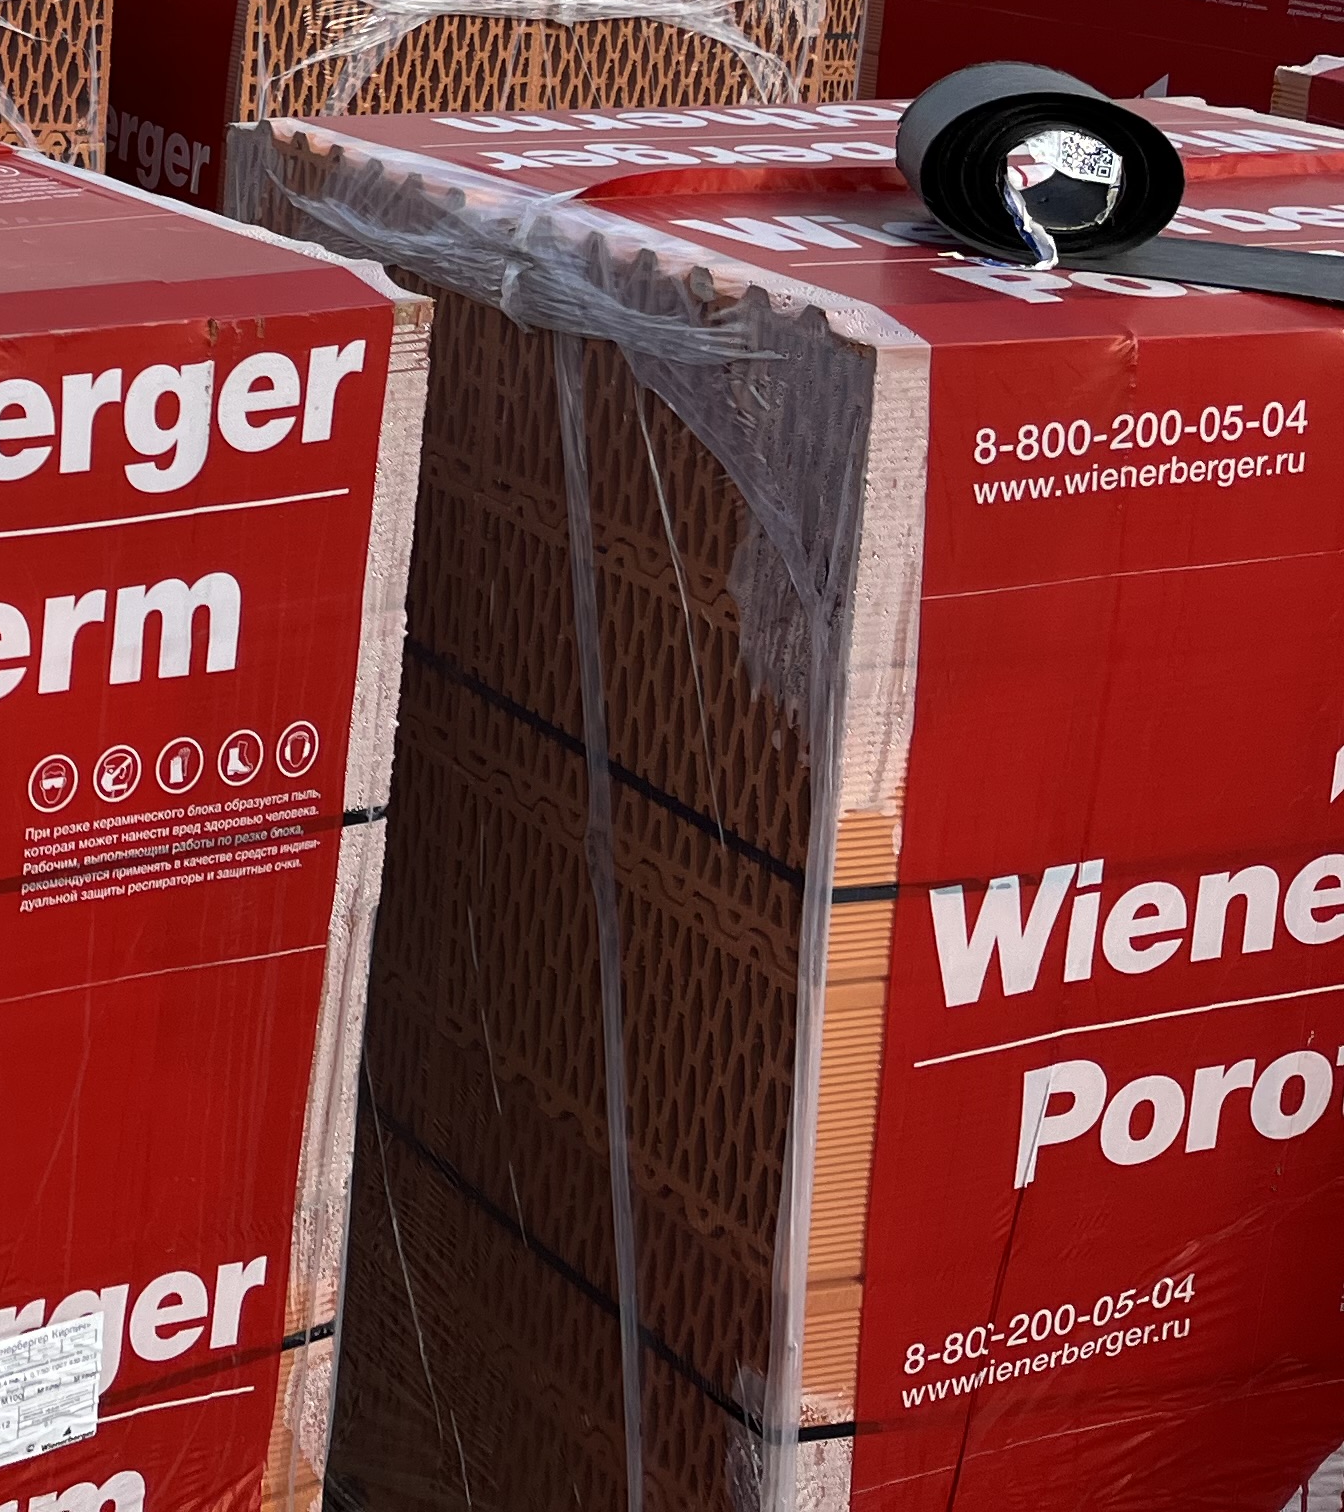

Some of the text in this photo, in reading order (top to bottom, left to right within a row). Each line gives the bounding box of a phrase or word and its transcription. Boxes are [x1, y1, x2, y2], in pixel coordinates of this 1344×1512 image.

[973, 399, 1309, 465] 8-800-200-05-04
[973, 451, 1306, 506] www.wienerberger.ru
[24, 805, 319, 859] которая может нанести вред здоровью человека.
[25, 789, 321, 842] При резке керамического блока образуется пыль,
[23, 825, 304, 876] Рабочим, выполняющим работы по резке блока,
[112, 861, 172, 880] применять
[174, 860, 181, 869] в
[183, 852, 233, 868] качестве
[235, 845, 278, 862] средств
[20, 889, 78, 913] дуальной
[80, 885, 125, 900] защиты
[127, 872, 204, 896] респираторы
[206, 871, 214, 881] и
[216, 863, 273, 879] защитные
[1014, 1043, 1344, 1190] Poro
